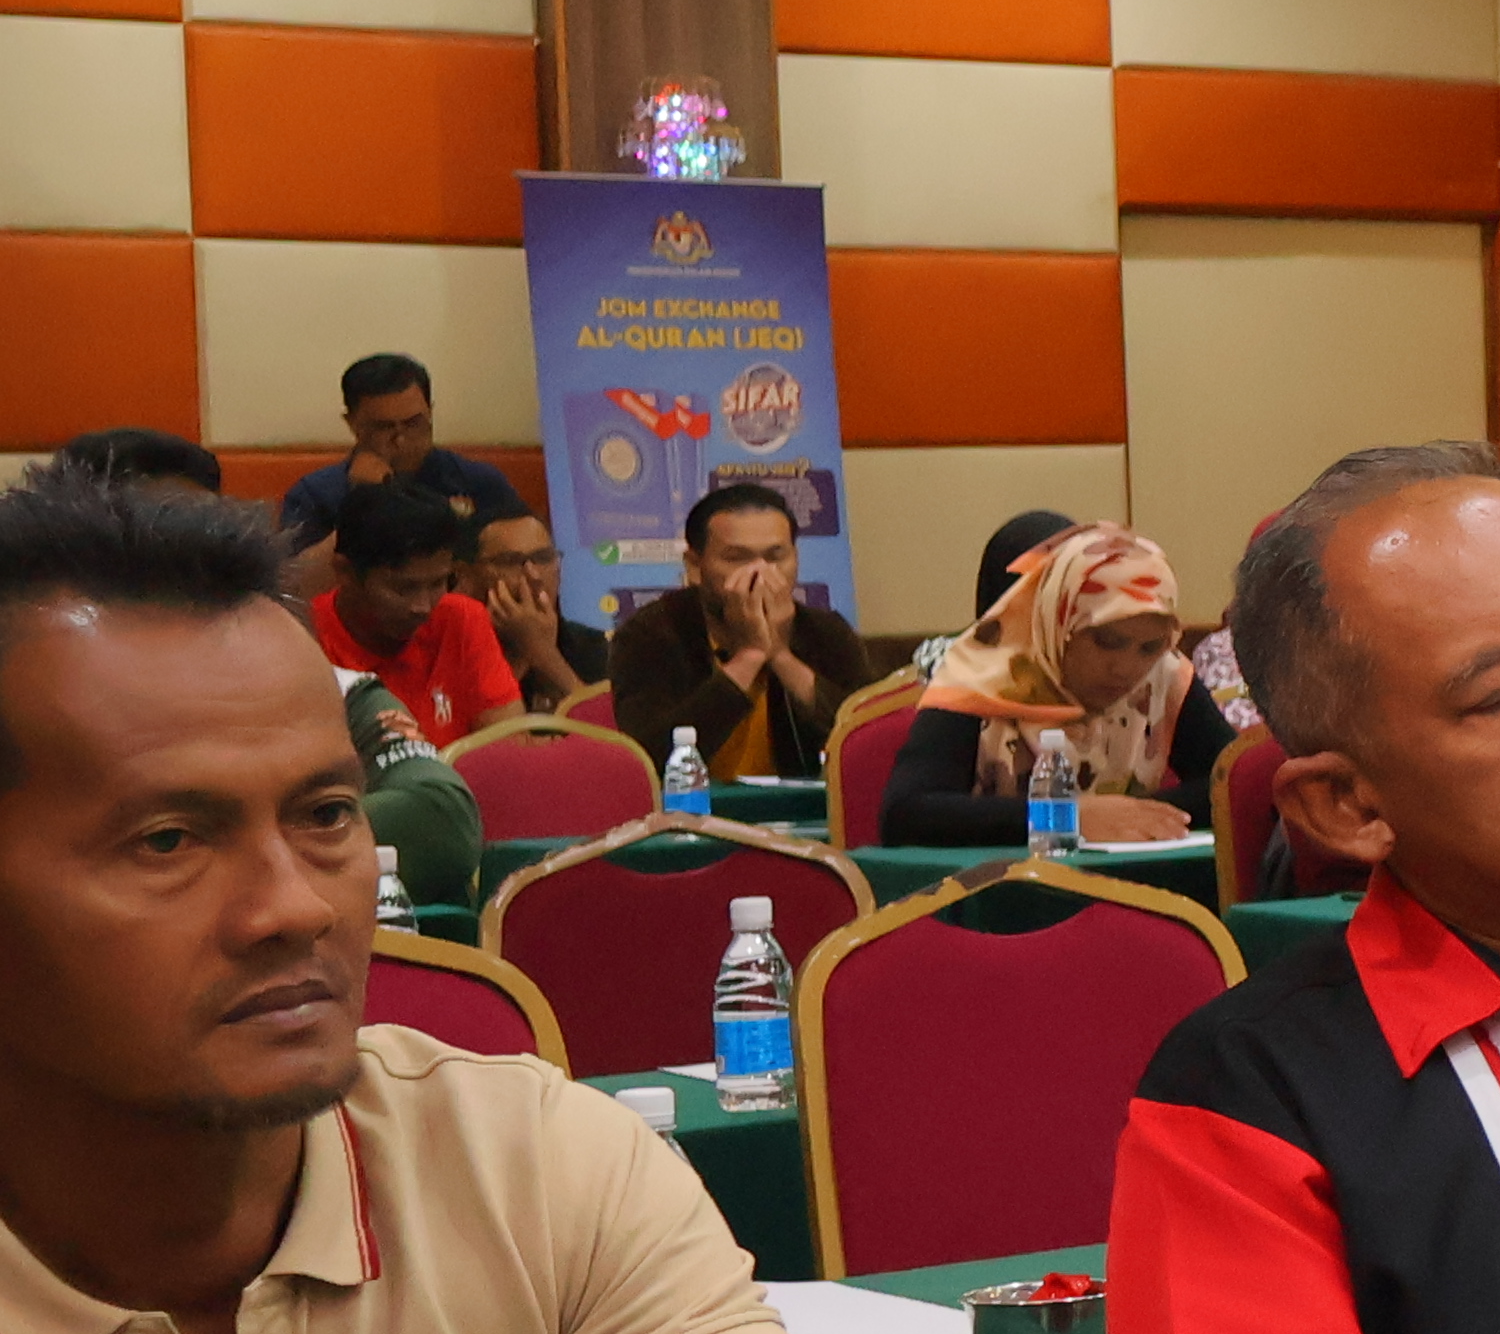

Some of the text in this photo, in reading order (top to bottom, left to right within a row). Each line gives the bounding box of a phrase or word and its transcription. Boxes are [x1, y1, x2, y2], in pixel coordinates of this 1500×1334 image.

[597, 298, 781, 319] JOM EXCHANGE
[576, 325, 805, 351] AL-QURAN (JEQ)
[721, 381, 801, 415] SIFAR
